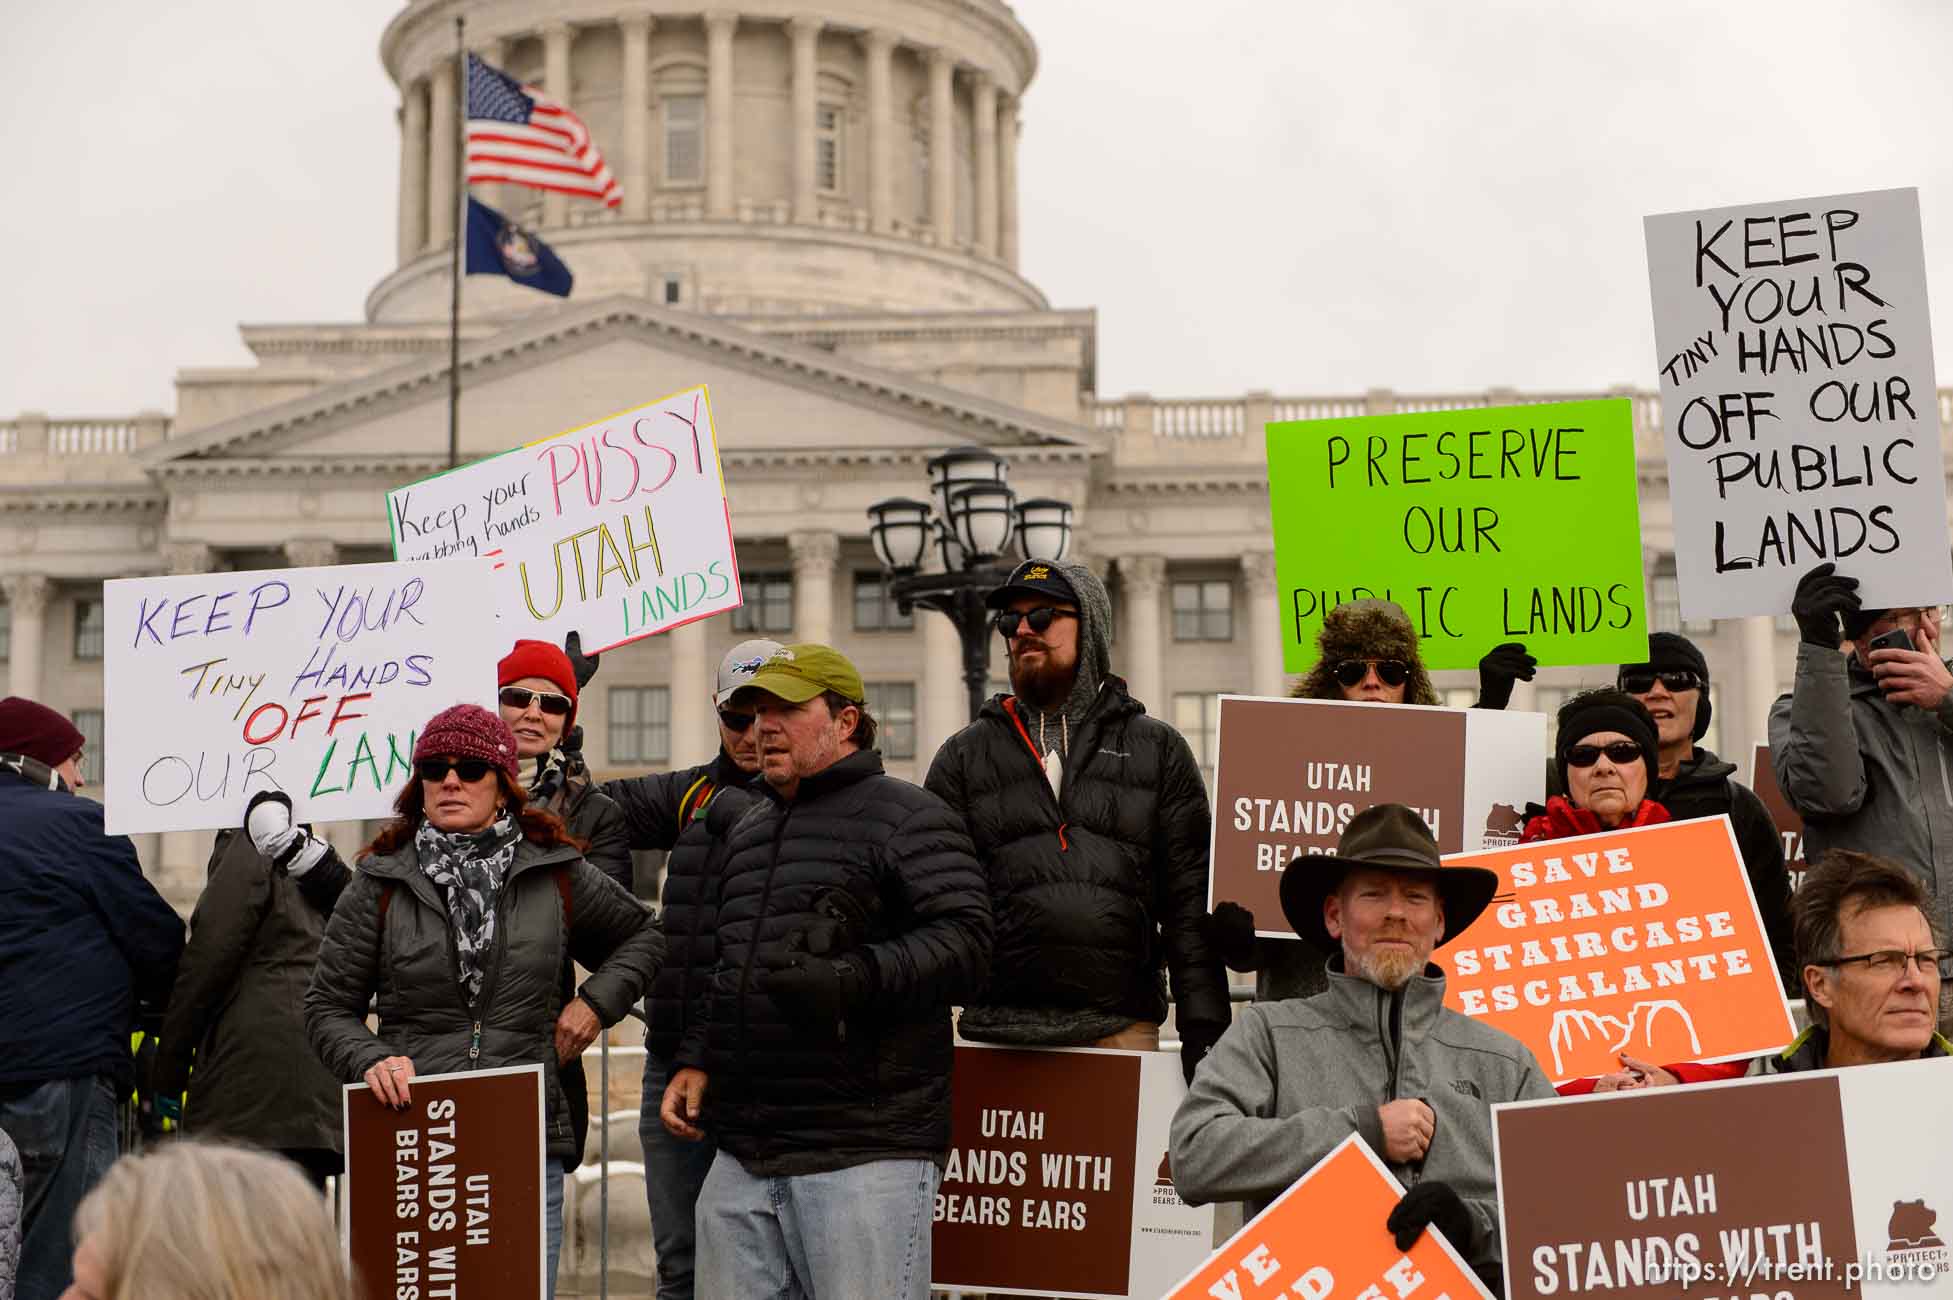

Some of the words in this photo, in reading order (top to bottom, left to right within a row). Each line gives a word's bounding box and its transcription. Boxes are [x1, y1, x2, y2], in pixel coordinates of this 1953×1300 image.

[1695, 209, 1860, 287] KEEP
[1707, 262, 1895, 334] YOUR
[1660, 330, 1720, 387] TINY
[1737, 319, 1897, 375] HANDS
[1677, 391, 1782, 450] OFF
[1809, 375, 1916, 422] OUR
[394, 491, 467, 543] Keep
[482, 472, 531, 523] your
[537, 394, 702, 516] PUSSY
[1328, 428, 1585, 488] PRESERVE
[1707, 438, 1919, 498] PUBLIC
[484, 504, 540, 541] hands
[1403, 505, 1501, 554] OUR
[1714, 504, 1901, 574] LANDS
[520, 504, 663, 621] UTAH
[134, 581, 291, 648] KEEP
[317, 577, 424, 642] YOUR
[623, 560, 729, 636] LANDS
[1502, 584, 1633, 636] LANDS
[290, 642, 433, 696] HANDS
[242, 692, 372, 745] OFF
[142, 747, 284, 806] OUR
[309, 730, 416, 799] LAN
[1306, 762, 1371, 792] UTAH
[1234, 797, 1355, 835] STANDS
[1510, 847, 1634, 888] SAVE
[1496, 882, 1670, 929] GRAND
[1453, 911, 1736, 976] STAIRCASE
[1459, 948, 1753, 1017] ESCALANTE
[981, 1109, 1045, 1140] UTAH
[395, 1129, 420, 1218] BEARS
[426, 1099, 457, 1231] STANDS
[943, 1148, 1028, 1187] ANDS
[1041, 1153, 1112, 1191] WITH
[1626, 1174, 1717, 1220] UTAH
[465, 1174, 489, 1245] UTAH
[933, 1193, 1011, 1226] BEARS
[1021, 1199, 1087, 1231] EARS
[396, 1231, 420, 1300] EARS
[428, 1246, 457, 1300] WIT
[1532, 1233, 1701, 1295] STANDS
[1719, 1222, 1824, 1277] WITH
